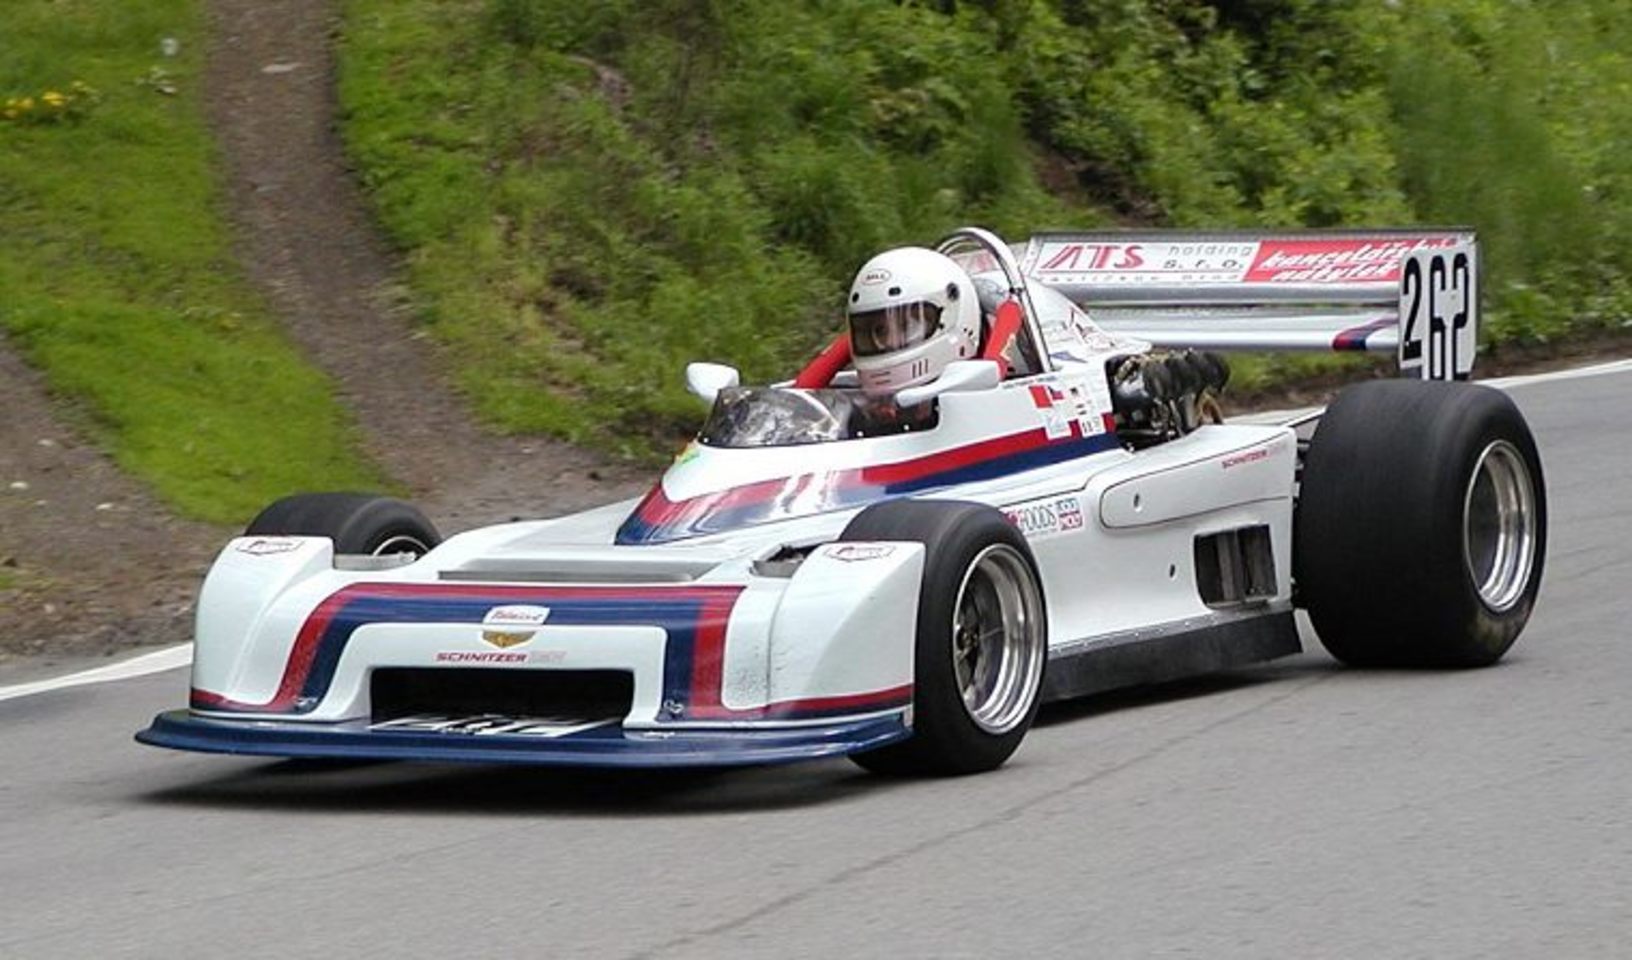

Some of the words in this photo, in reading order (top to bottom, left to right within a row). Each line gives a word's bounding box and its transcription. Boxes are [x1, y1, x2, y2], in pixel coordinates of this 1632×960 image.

[1040, 244, 1144, 269] ATS
[1167, 244, 1253, 257] holding
[1402, 252, 1470, 381] 262
[436, 652, 528, 662] SCHNITZER
